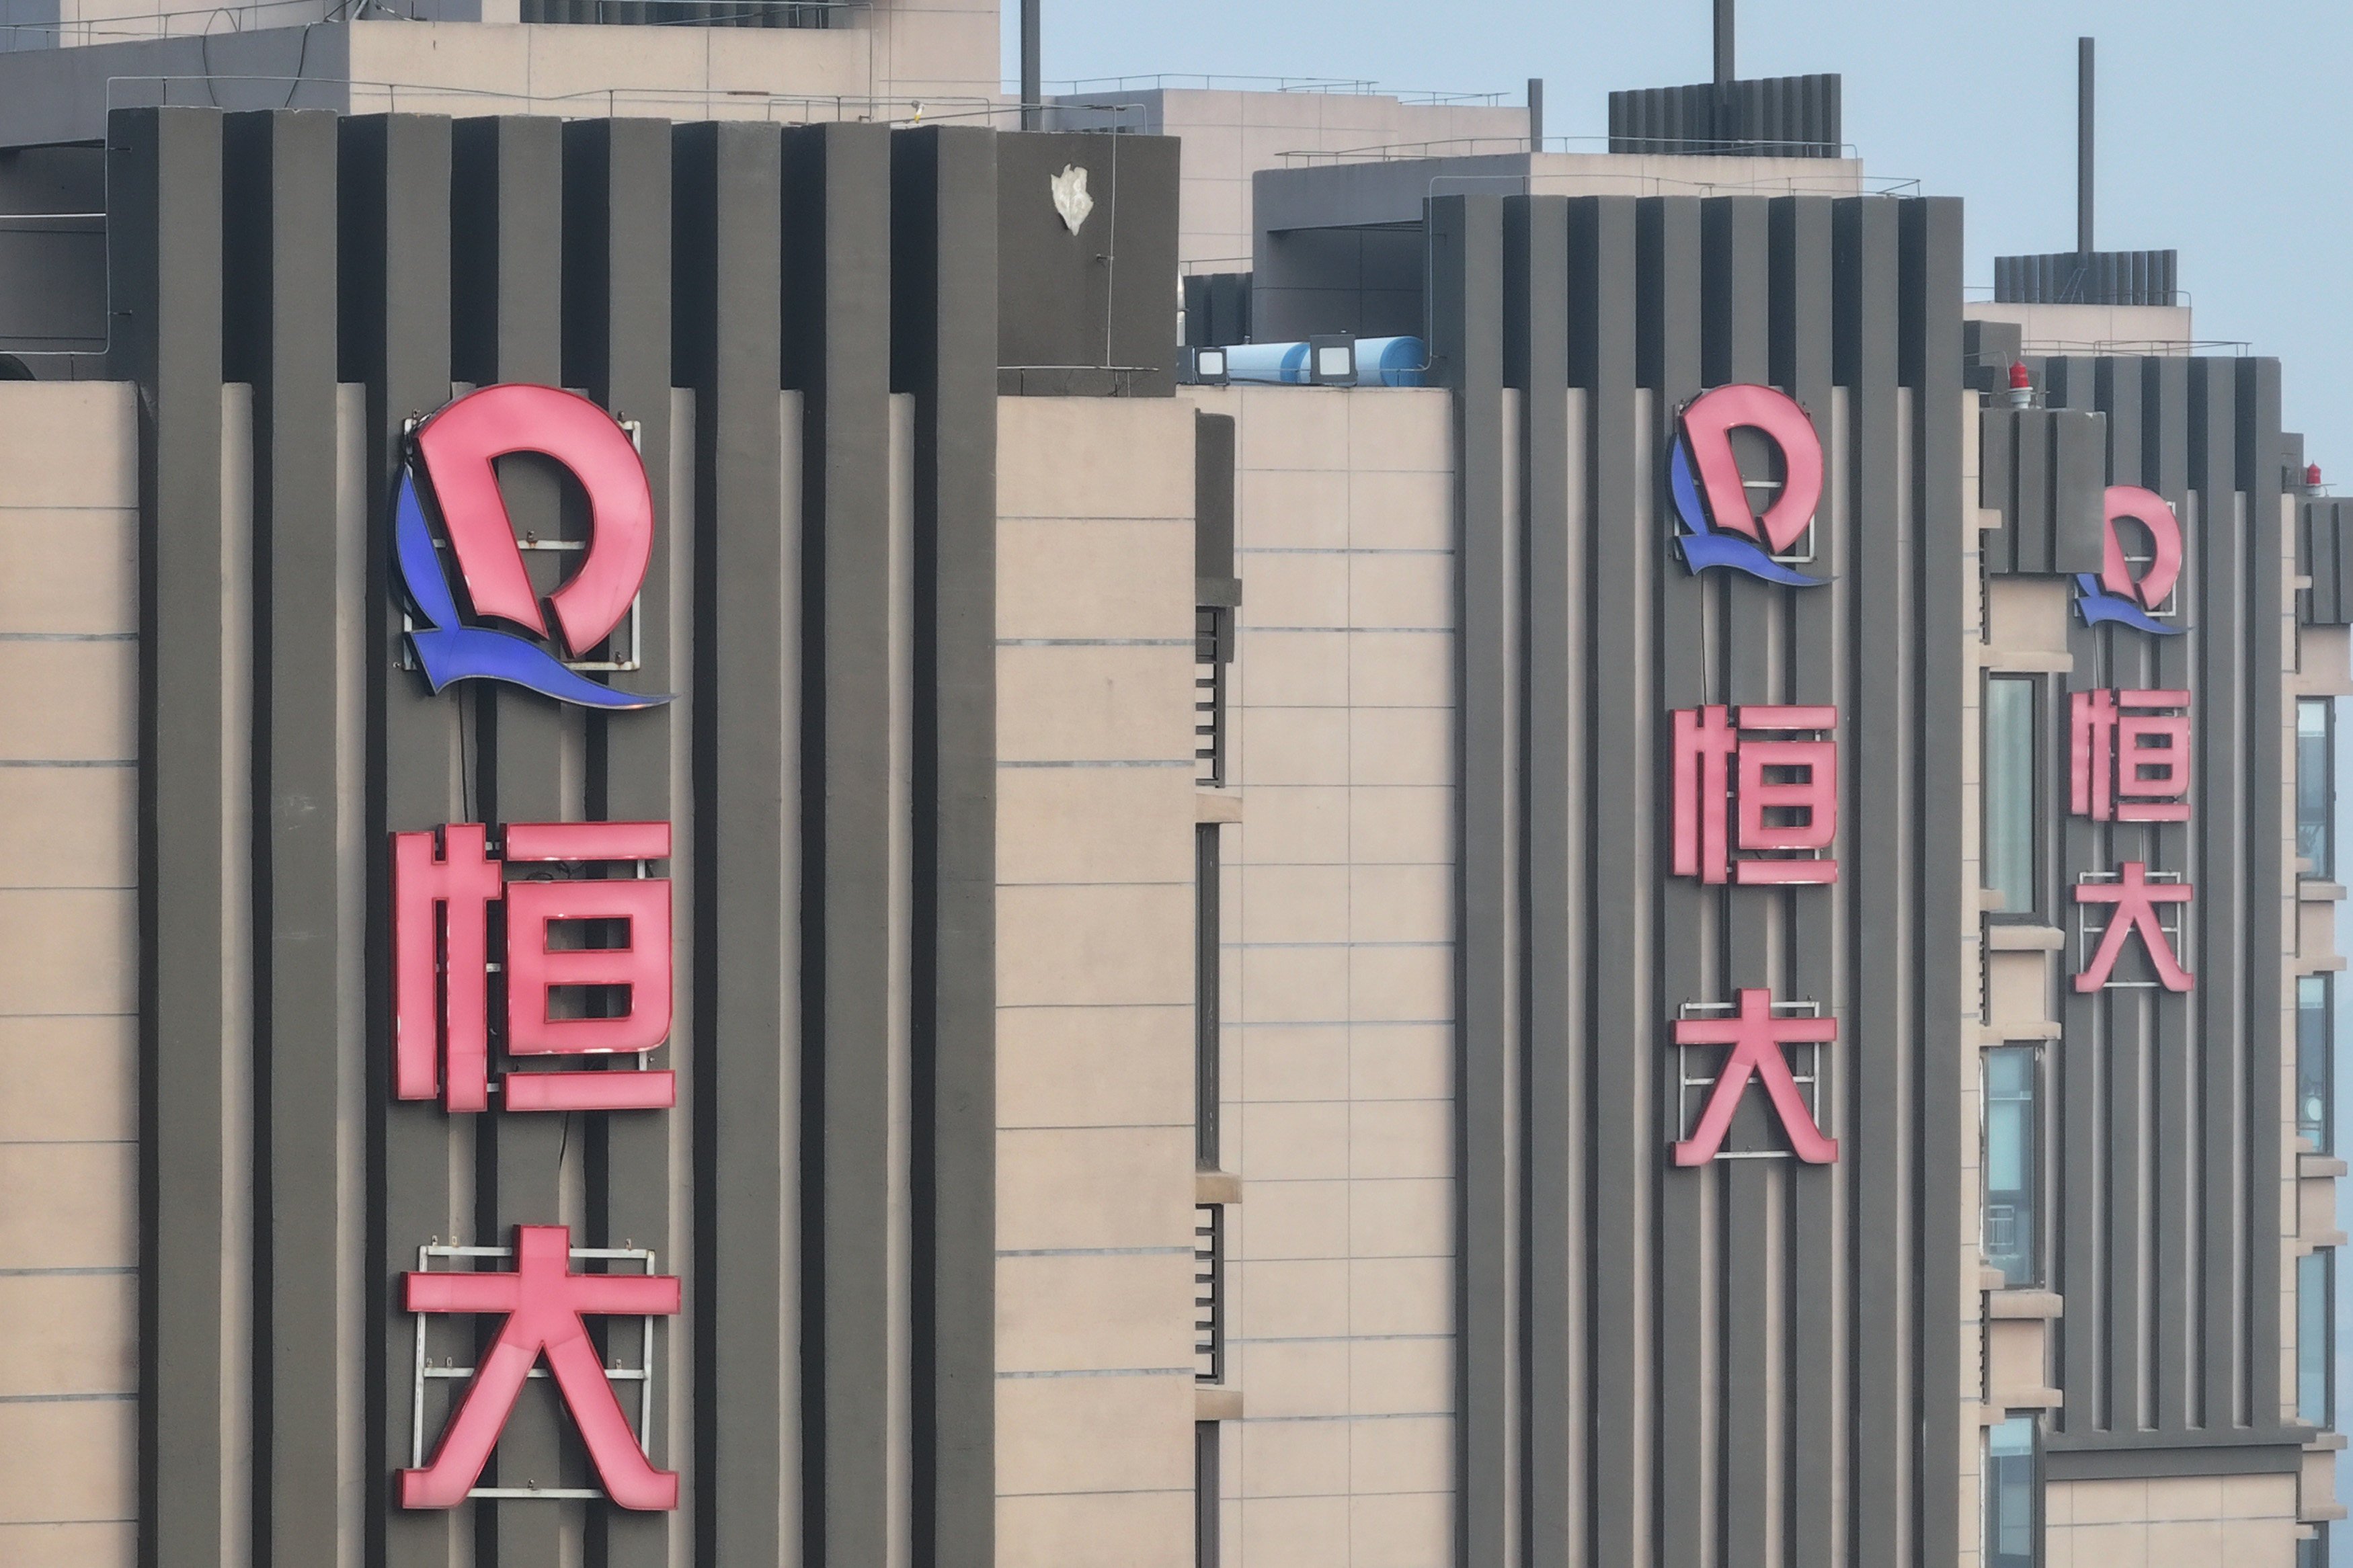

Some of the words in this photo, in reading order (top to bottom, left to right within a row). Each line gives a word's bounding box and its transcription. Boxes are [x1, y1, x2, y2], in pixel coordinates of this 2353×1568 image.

[1672, 705, 1838, 1166] 恒大
[2071, 689, 2194, 992] 恒大
[391, 822, 680, 1510] 恒大
